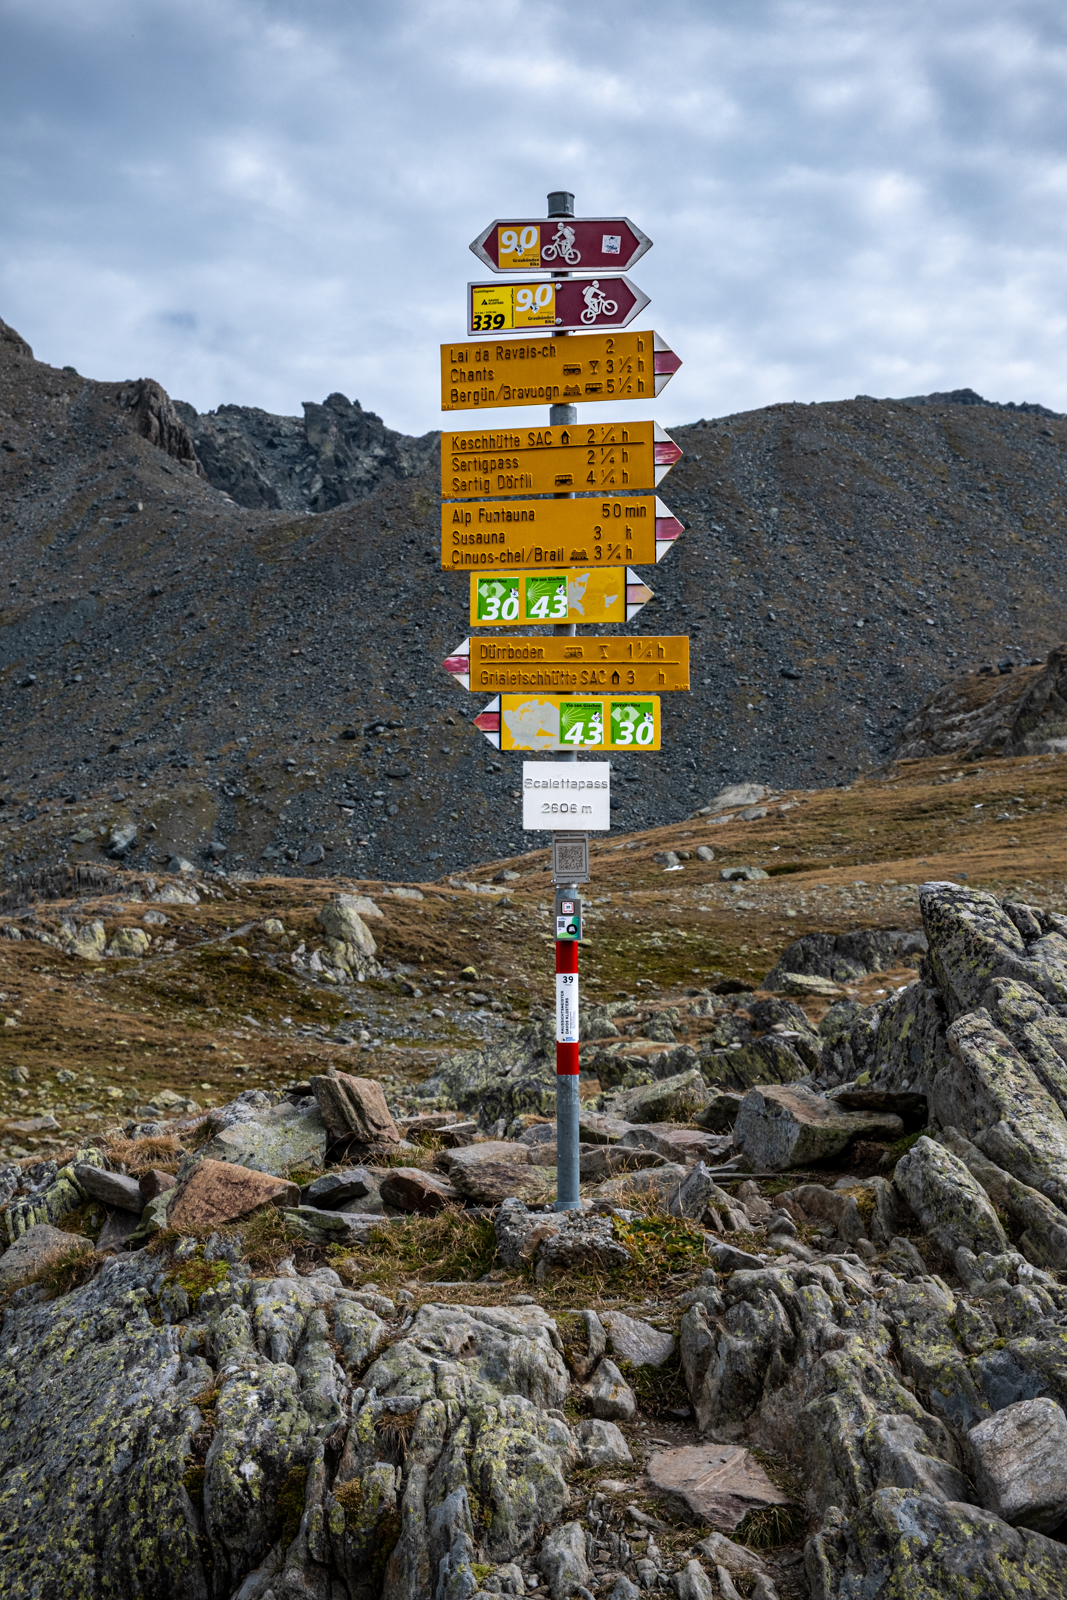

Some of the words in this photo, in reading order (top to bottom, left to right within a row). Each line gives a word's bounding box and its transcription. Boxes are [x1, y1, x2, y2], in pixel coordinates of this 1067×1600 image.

[500, 226, 538, 254] 90
[515, 283, 553, 312] 90
[473, 313, 505, 331] 339
[450, 348, 469, 363] Lai
[475, 347, 490, 362] da
[496, 342, 556, 361] Ravais-ch
[606, 338, 615, 354] 2
[637, 335, 645, 352] h
[450, 367, 496, 383] Chants
[606, 358, 615, 373] 3
[637, 355, 645, 372] h
[450, 382, 560, 405] Bergün/Bravuogn
[606, 378, 615, 393] 5
[637, 375, 645, 393] h
[452, 432, 521, 451] Keschhütte
[527, 430, 553, 446] SAC
[622, 425, 630, 442] h
[452, 456, 519, 474] Sertigpass
[622, 447, 630, 463] h
[452, 476, 490, 493] Sertig
[497, 472, 533, 490] Dörfli
[622, 467, 630, 484] h
[452, 508, 472, 527] Alp
[478, 507, 536, 523] Funtauna
[602, 502, 622, 518] 50
[625, 502, 647, 518] min
[452, 530, 506, 545] Susauna
[594, 525, 602, 540] 3
[625, 523, 633, 540] h
[452, 544, 564, 564] Cinuos-chel/Brail
[625, 543, 634, 560] h
[481, 597, 519, 620] 30
[530, 595, 568, 619] 43
[480, 642, 545, 659] Dürrboden
[657, 642, 666, 659] h
[480, 668, 577, 685] Grialetschhütte
[581, 669, 607, 685] SAC
[627, 669, 636, 685] 3
[658, 668, 667, 685] h
[564, 722, 603, 745] 43
[615, 721, 654, 745] 30
[524, 777, 608, 791] Scalettapass
[541, 802, 578, 814] 2606
[581, 805, 593, 814] m
[562, 975, 574, 984] 39
